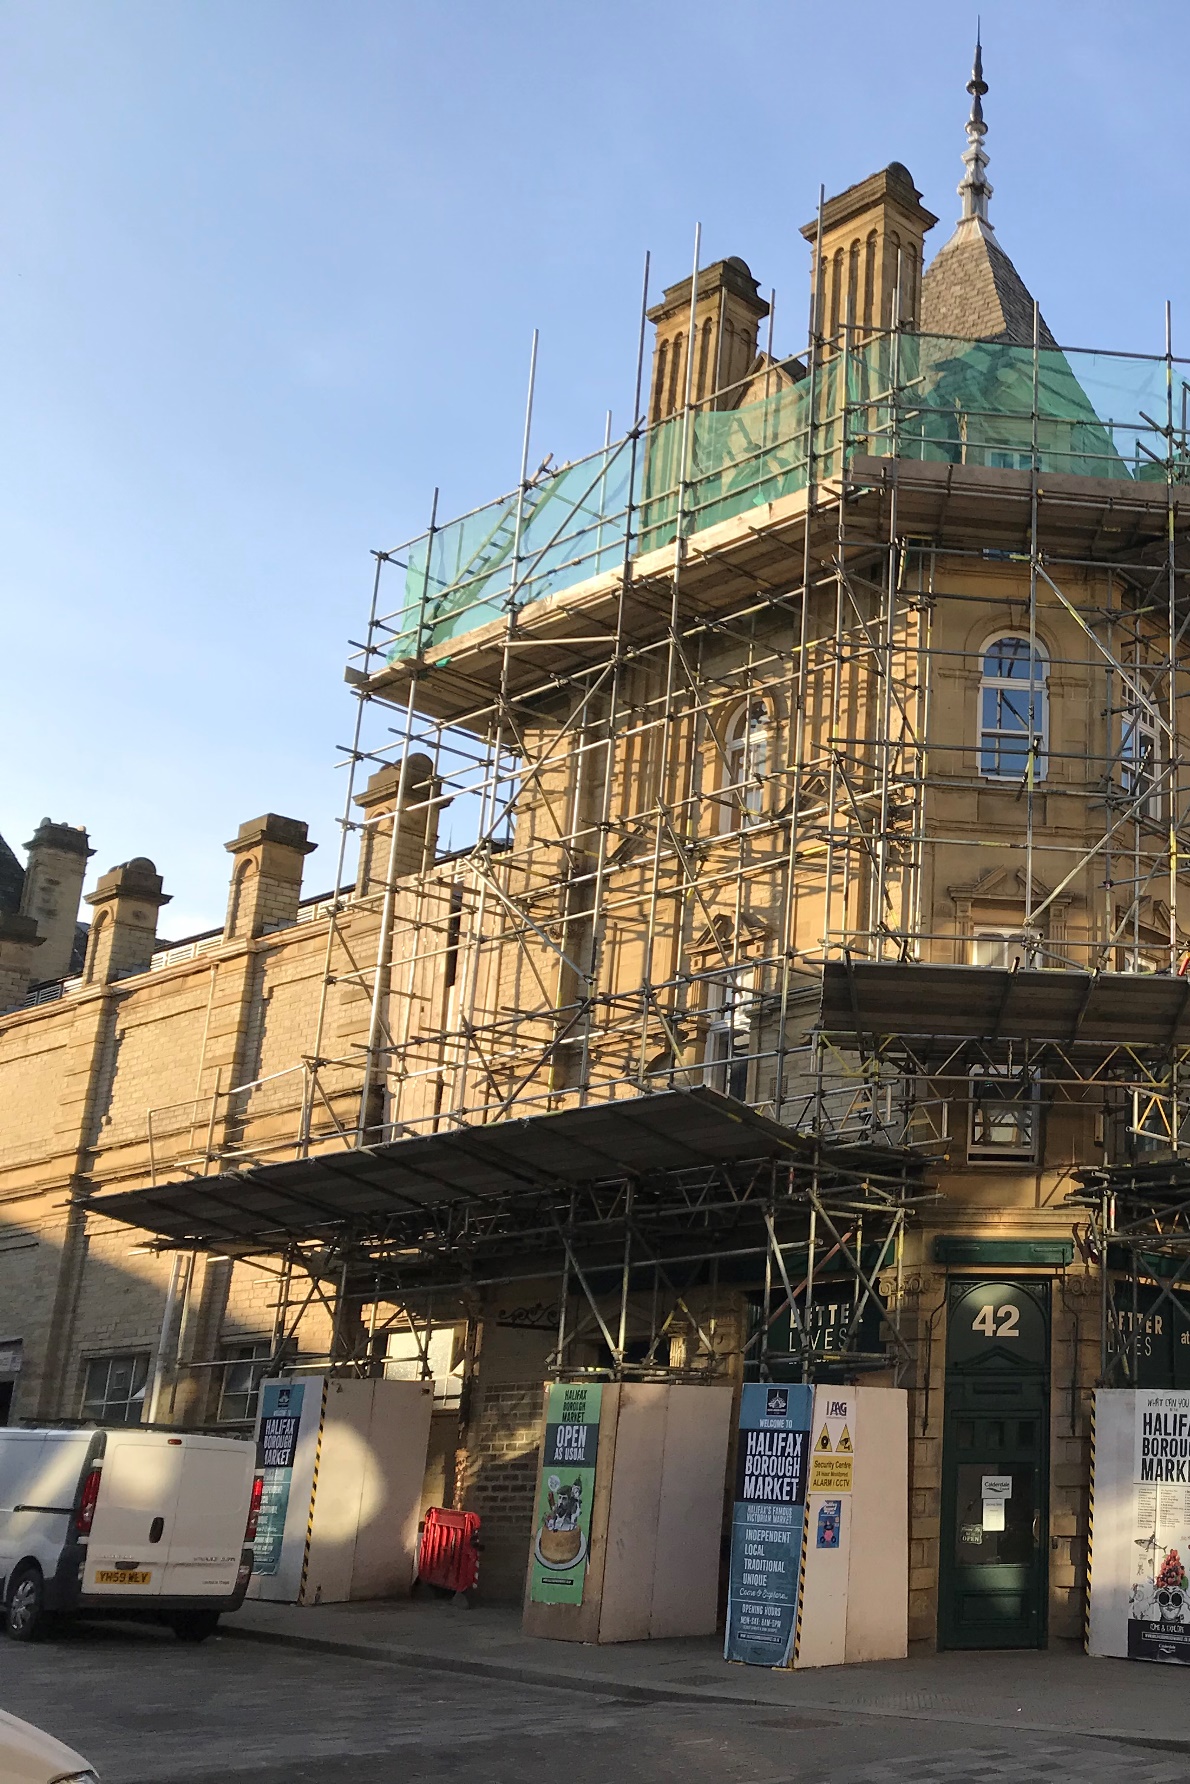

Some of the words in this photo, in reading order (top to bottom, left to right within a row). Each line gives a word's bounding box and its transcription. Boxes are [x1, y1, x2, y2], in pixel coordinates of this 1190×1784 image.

[972, 1304, 1020, 1337] 42
[789, 1327, 848, 1352] LVES
[1180, 1331, 1190, 1345] at
[564, 1389, 588, 1401] HALIFAX
[562, 1402, 586, 1412] BOROUGH
[1148, 1398, 1164, 1407] WHAT
[1165, 1398, 1177, 1407] CAN
[1178, 1398, 1190, 1408] YOU
[561, 1412, 585, 1423] MARKET
[760, 1419, 784, 1428] WELCOME
[785, 1420, 793, 1429] TO
[265, 1418, 296, 1435] HALIFAX
[264, 1435, 293, 1449] BOROUGH
[556, 1425, 587, 1447] OPEN
[747, 1431, 803, 1457] HALIFAX
[553, 1447, 563, 1460] AS
[564, 1447, 586, 1460] USUAL
[745, 1455, 801, 1477] BOROUGH
[814, 1460, 834, 1470] Security
[835, 1461, 852, 1470] Centre
[743, 1476, 799, 1502] MARKET
[813, 1479, 832, 1487] ALARM
[836, 1480, 850, 1488] CCTV
[746, 1513, 771, 1523] VICTORIAN
[772, 1515, 792, 1524] MARKET
[772, 1506, 792, 1517] FAMOUS
[745, 1528, 792, 1544] INDEPENDENT
[744, 1543, 765, 1557] LOCAL
[743, 1557, 786, 1573] TRADITIONAL
[742, 1573, 768, 1587] UNIQUE
[741, 1603, 764, 1615] OPENING
[764, 1606, 782, 1617] HOURS
